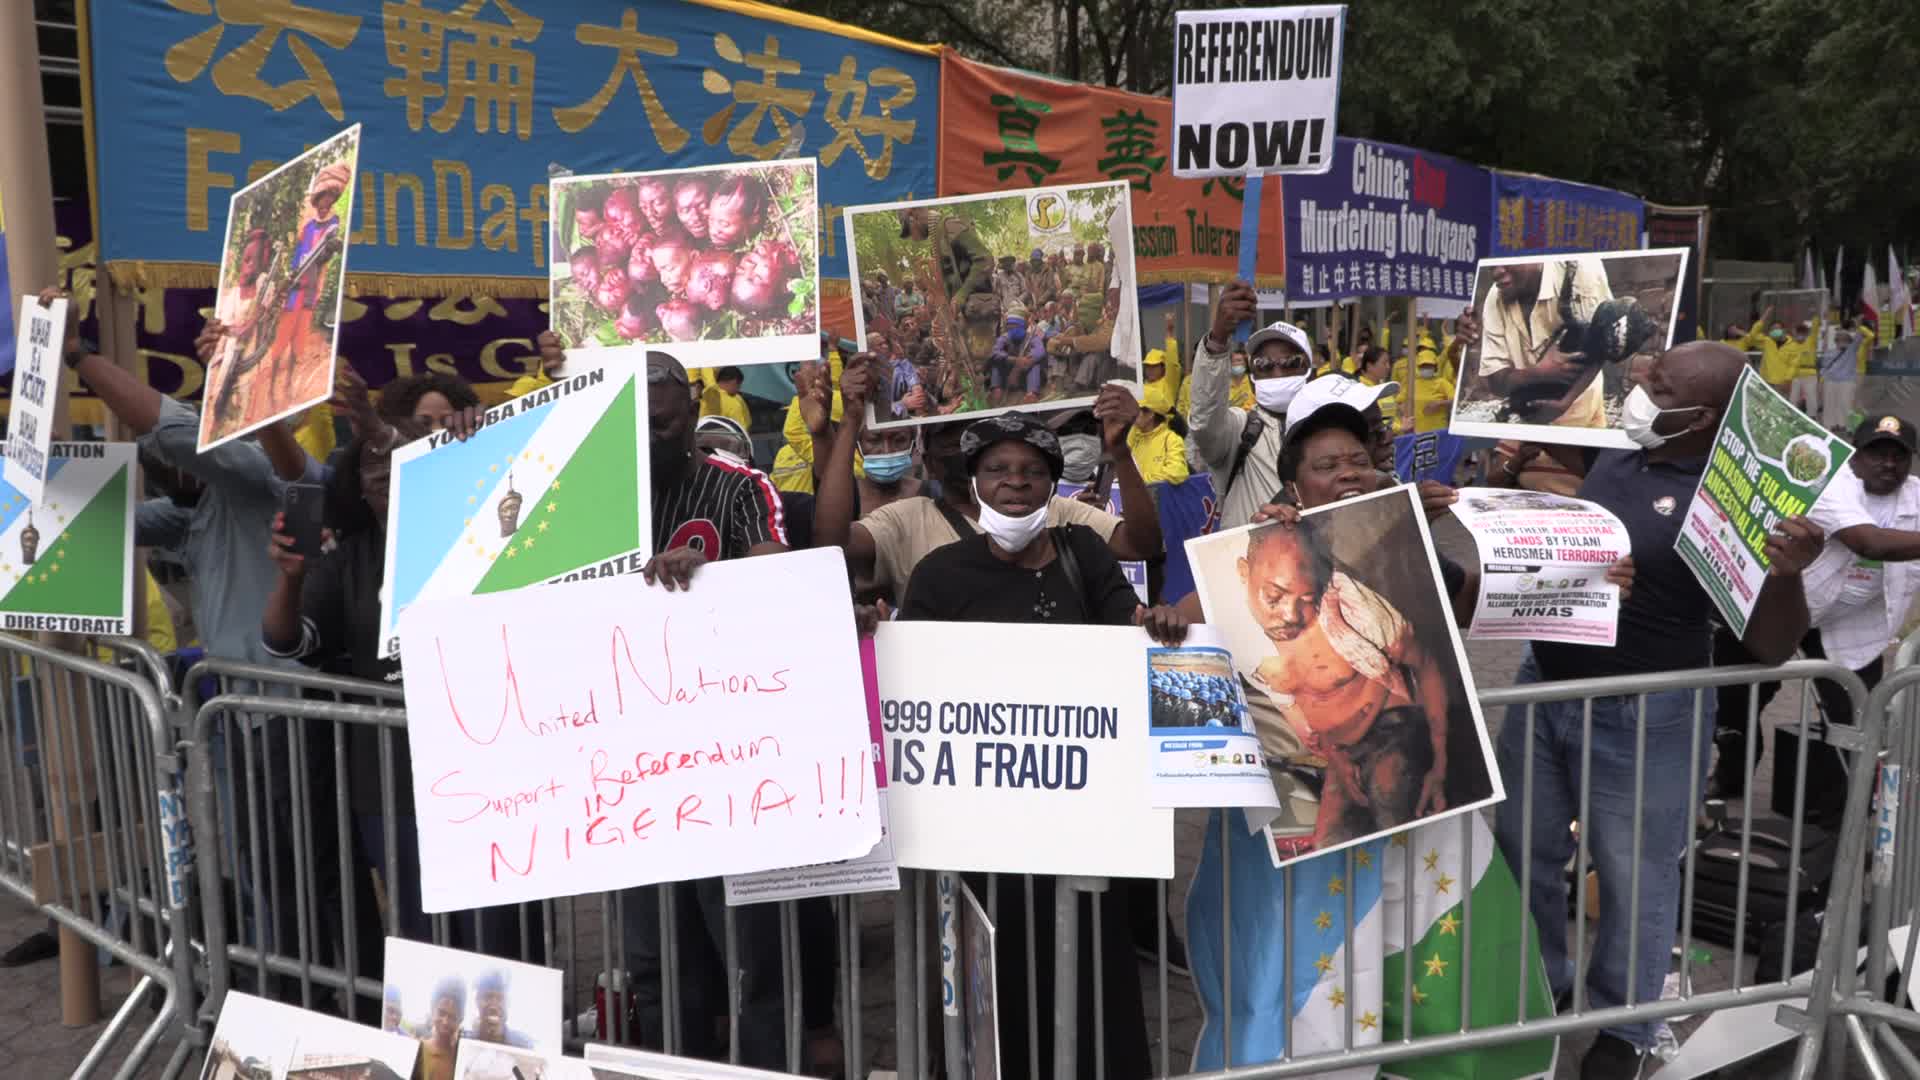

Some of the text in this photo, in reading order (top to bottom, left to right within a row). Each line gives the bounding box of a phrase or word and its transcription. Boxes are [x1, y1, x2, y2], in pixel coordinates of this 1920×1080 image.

[1177, 17, 1335, 84] REFERENDUM
[165, 0, 917, 180] 法輪大法好
[1178, 118, 1326, 170] NOW!
[1352, 142, 1409, 200] China:
[1300, 199, 1397, 259] Murdering
[1400, 202, 1424, 255] for
[1425, 207, 1477, 264] Organs
[428, 367, 605, 450] YOBA NATION
[52, 443, 105, 459] ATION
[1721, 426, 1746, 460] STOP
[1743, 451, 1762, 483] THE
[1704, 468, 1752, 537] ANCESTRAL
[1712, 447, 1753, 505] INVASION
[1750, 495, 1767, 518] OF
[1493, 547, 1618, 563] HERDSMEN TERRORISTS
[1506, 535, 1601, 547] LANDS BY FULANI
[1552, 526, 1617, 535] ANCESTRAL
[5, 614, 125, 634] DIRECTORATE
[1512, 607, 1574, 617] NINAS
[436, 616, 791, 745] United Nations
[881, 700, 1119, 740] 999 CONSTITUTION
[431, 735, 781, 824] Support Referendum
[892, 738, 925, 786] IS
[932, 741, 957, 786] A
[975, 742, 1089, 791] FRAUD
[583, 784, 625, 818] IN
